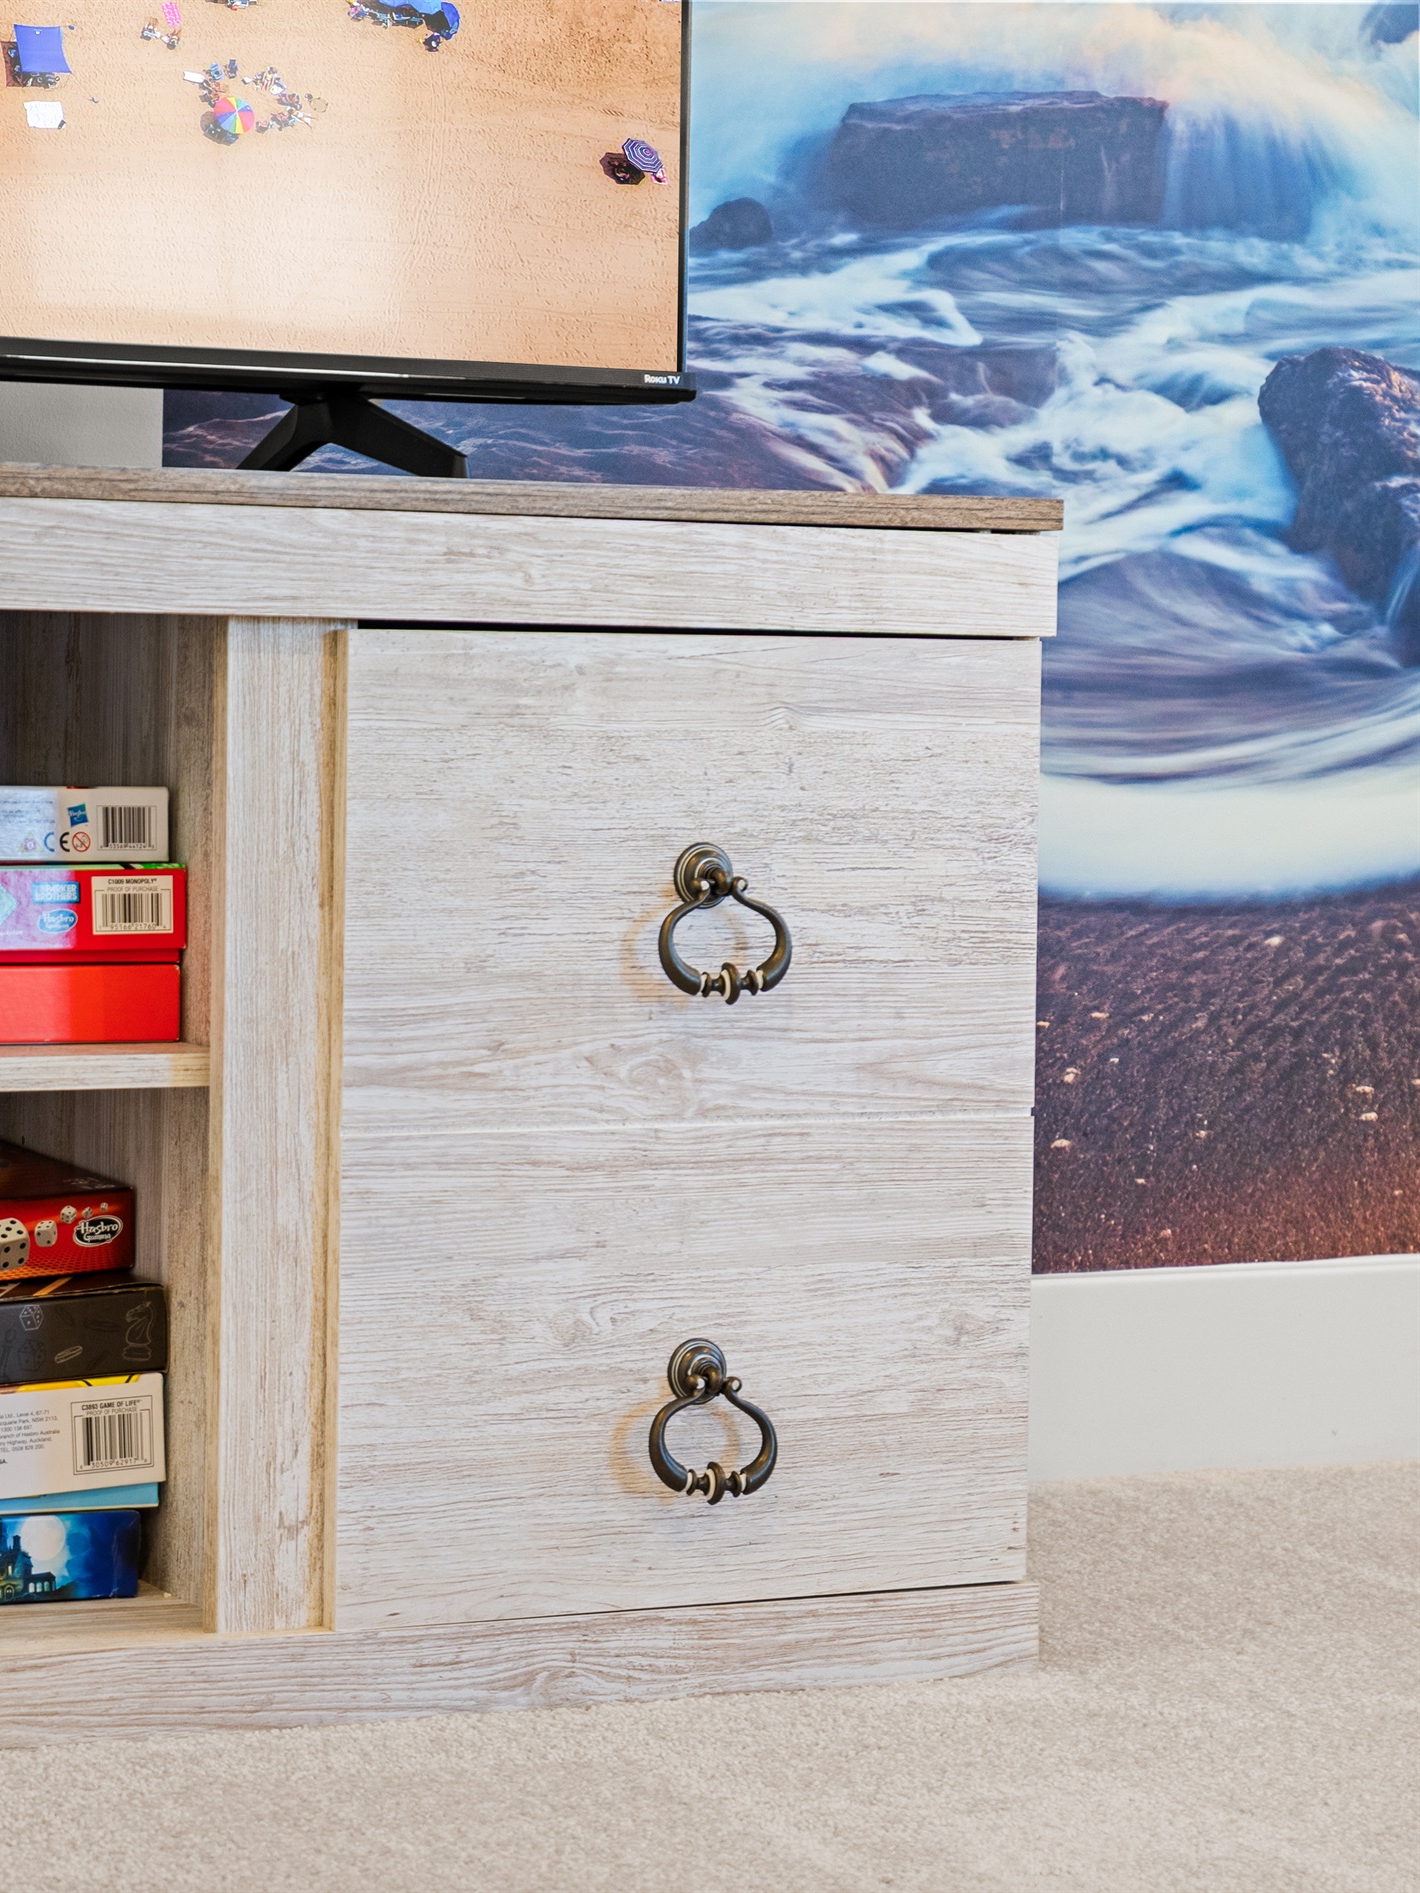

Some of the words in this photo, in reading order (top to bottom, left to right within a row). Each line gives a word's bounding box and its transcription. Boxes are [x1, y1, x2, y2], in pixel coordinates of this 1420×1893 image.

[644, 374, 667, 384] Roku
[668, 375, 681, 385] TV
[35, 893, 77, 901] BROTHERS
[76, 1221, 119, 1235] Hasbro
[81, 1403, 99, 1411] C3893
[99, 1401, 115, 1410] GAME
[111, 1406, 138, 1414] PURCHASE
[22, 1430, 39, 1438] Hasbro
[40, 1428, 61, 1436] Australia
[7, 1438, 29, 1446] Highway,
[91, 1460, 113, 1469] 30509
[115, 1457, 137, 1466] 62917
